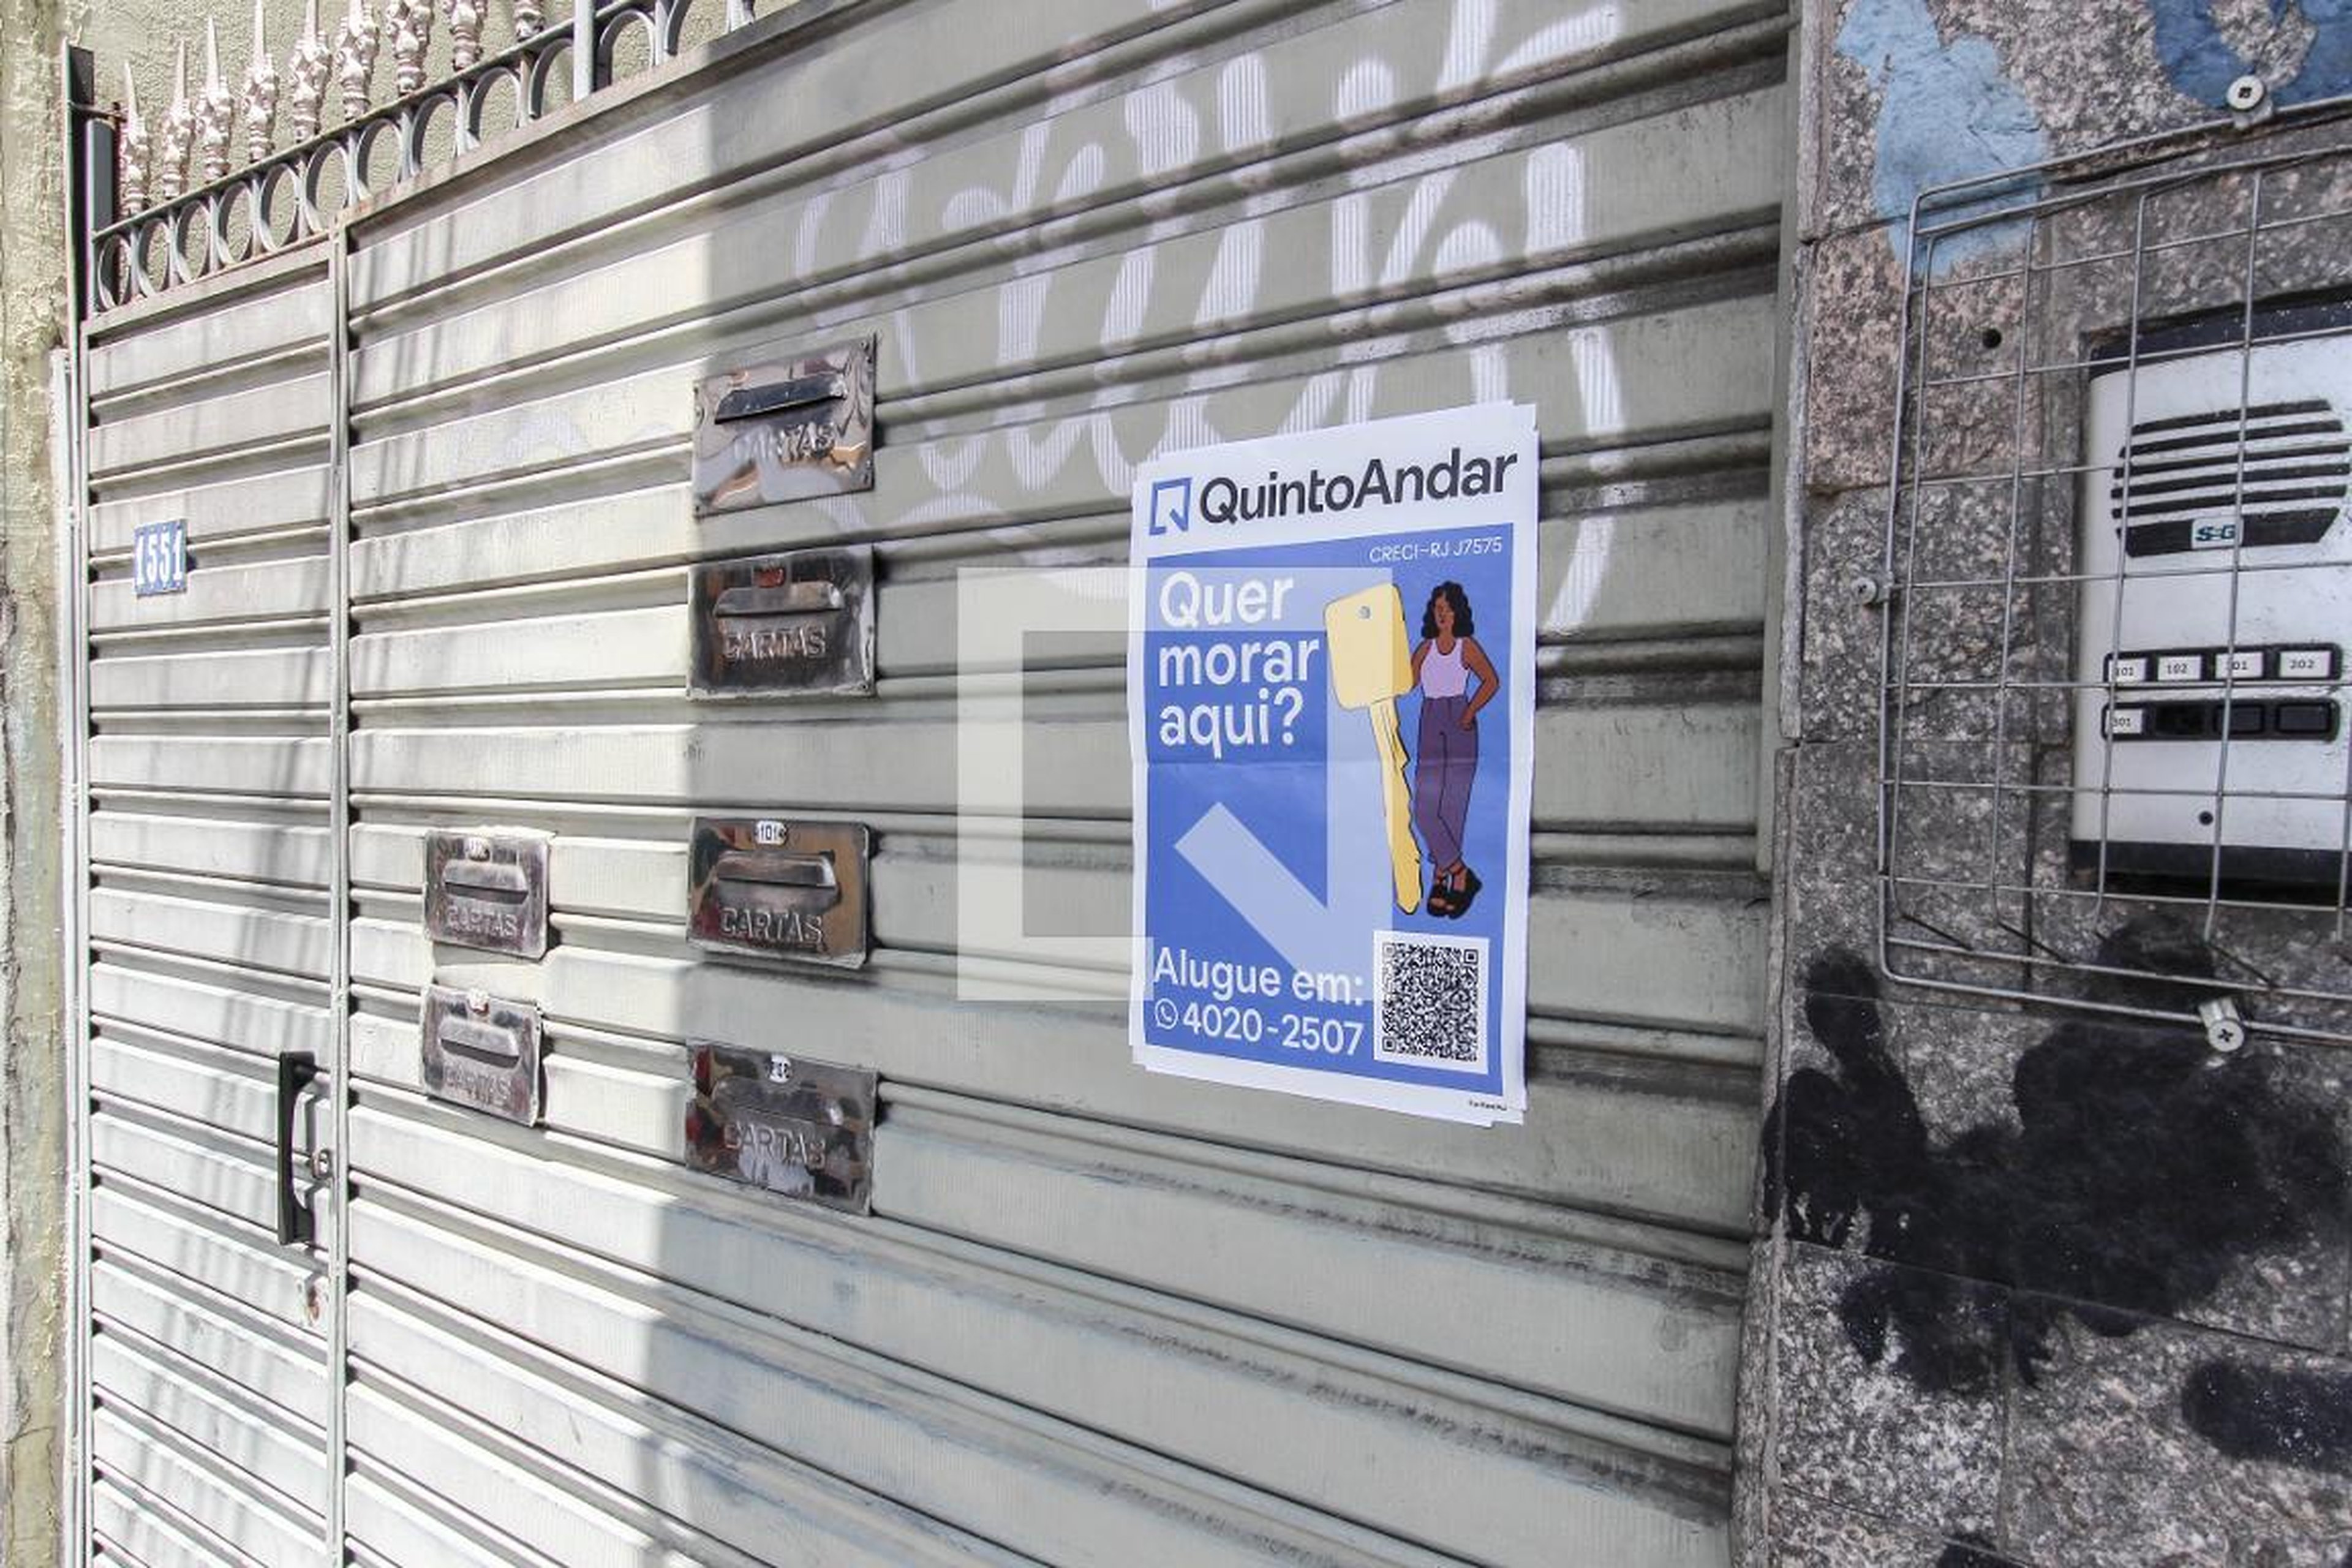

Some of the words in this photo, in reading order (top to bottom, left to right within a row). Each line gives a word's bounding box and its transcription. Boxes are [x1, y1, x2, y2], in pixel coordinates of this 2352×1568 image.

[1199, 447, 1518, 525] QuintoAndar
[135, 529, 183, 586] 1551
[1369, 541, 1449, 563] CRECI-RJ
[1452, 536, 1503, 556] J7575
[1159, 571, 1295, 629] Quer
[1158, 637, 1320, 687] morar
[1159, 687, 1305, 760] aqui?
[720, 907, 824, 944] CARTAS
[1154, 947, 1281, 1001] Alugue
[1291, 970, 1364, 1006] em:
[1182, 1002, 1365, 1056] 4020-2507
[723, 1120, 827, 1170] CARTAS
